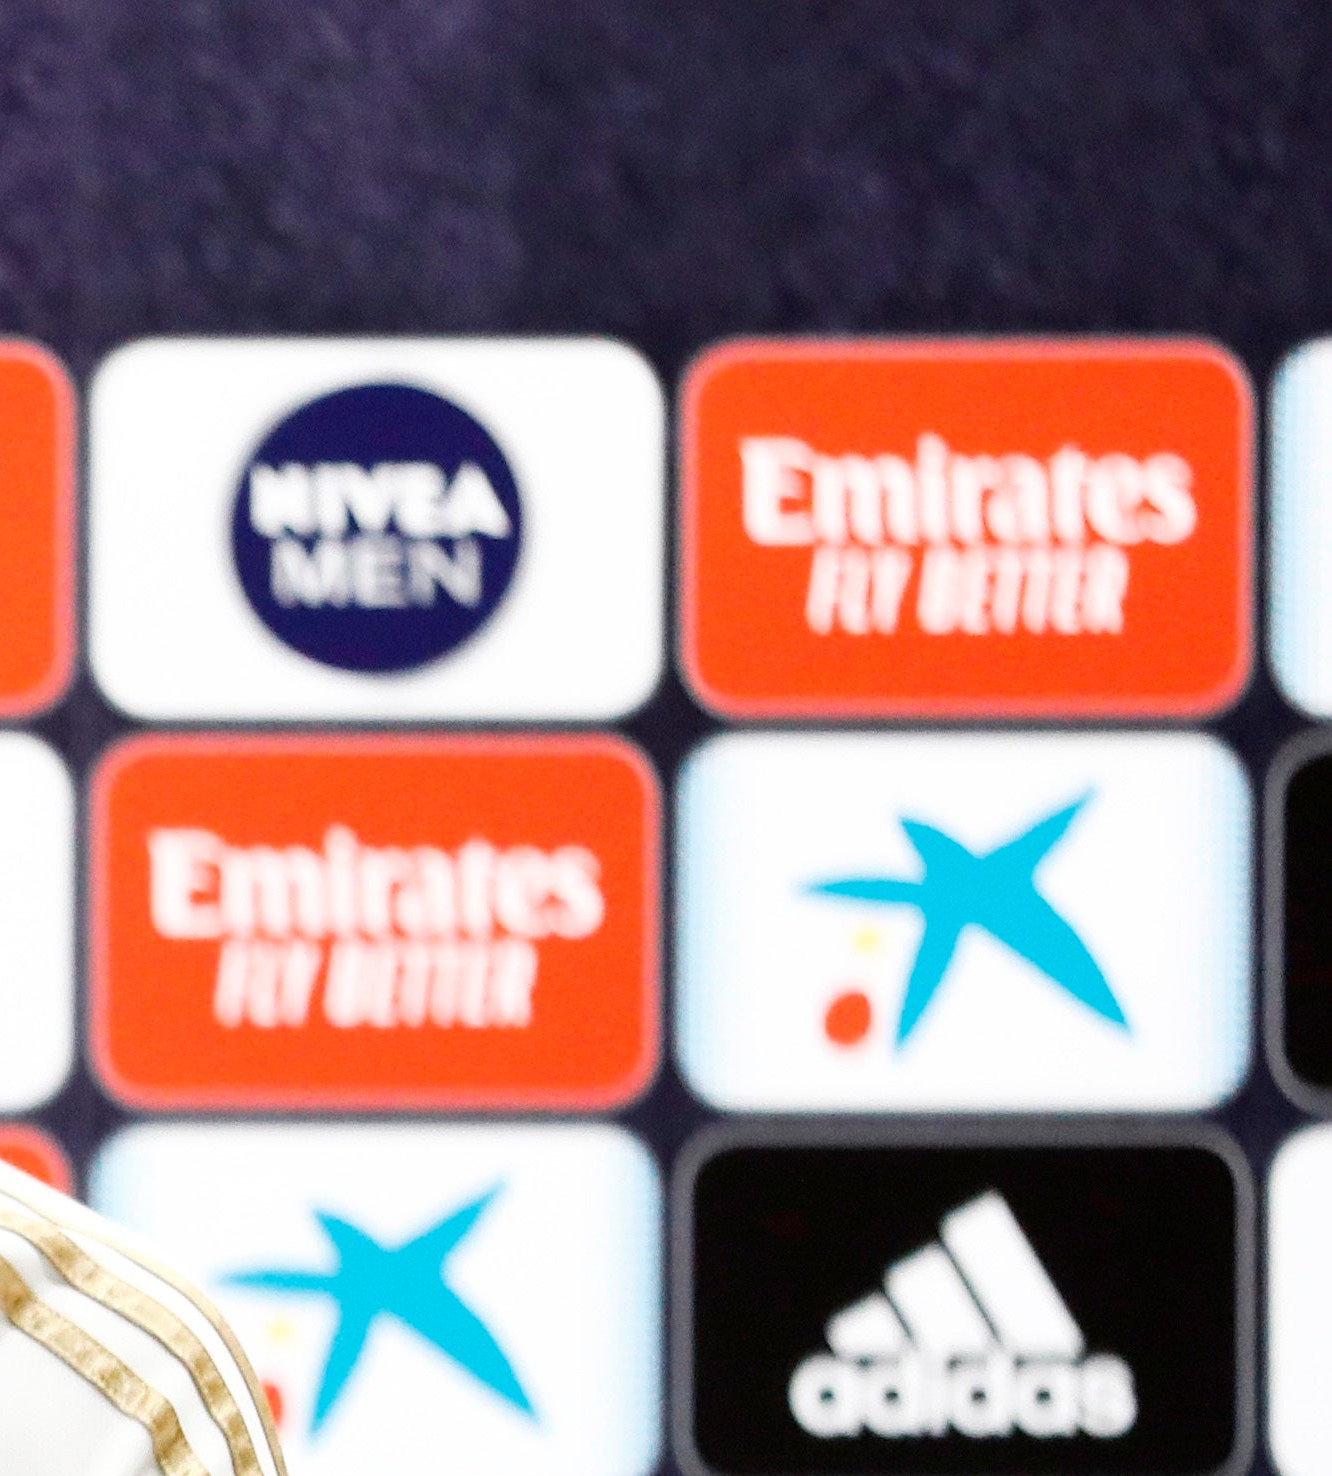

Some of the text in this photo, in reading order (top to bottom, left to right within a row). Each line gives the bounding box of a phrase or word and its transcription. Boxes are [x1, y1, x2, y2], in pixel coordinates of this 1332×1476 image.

[248, 461, 510, 540] NIVEA
[739, 434, 1197, 547] Emirates
[269, 542, 482, 608] MEN
[147, 826, 605, 939] Emirates
[789, 1349, 1137, 1438] adidas
